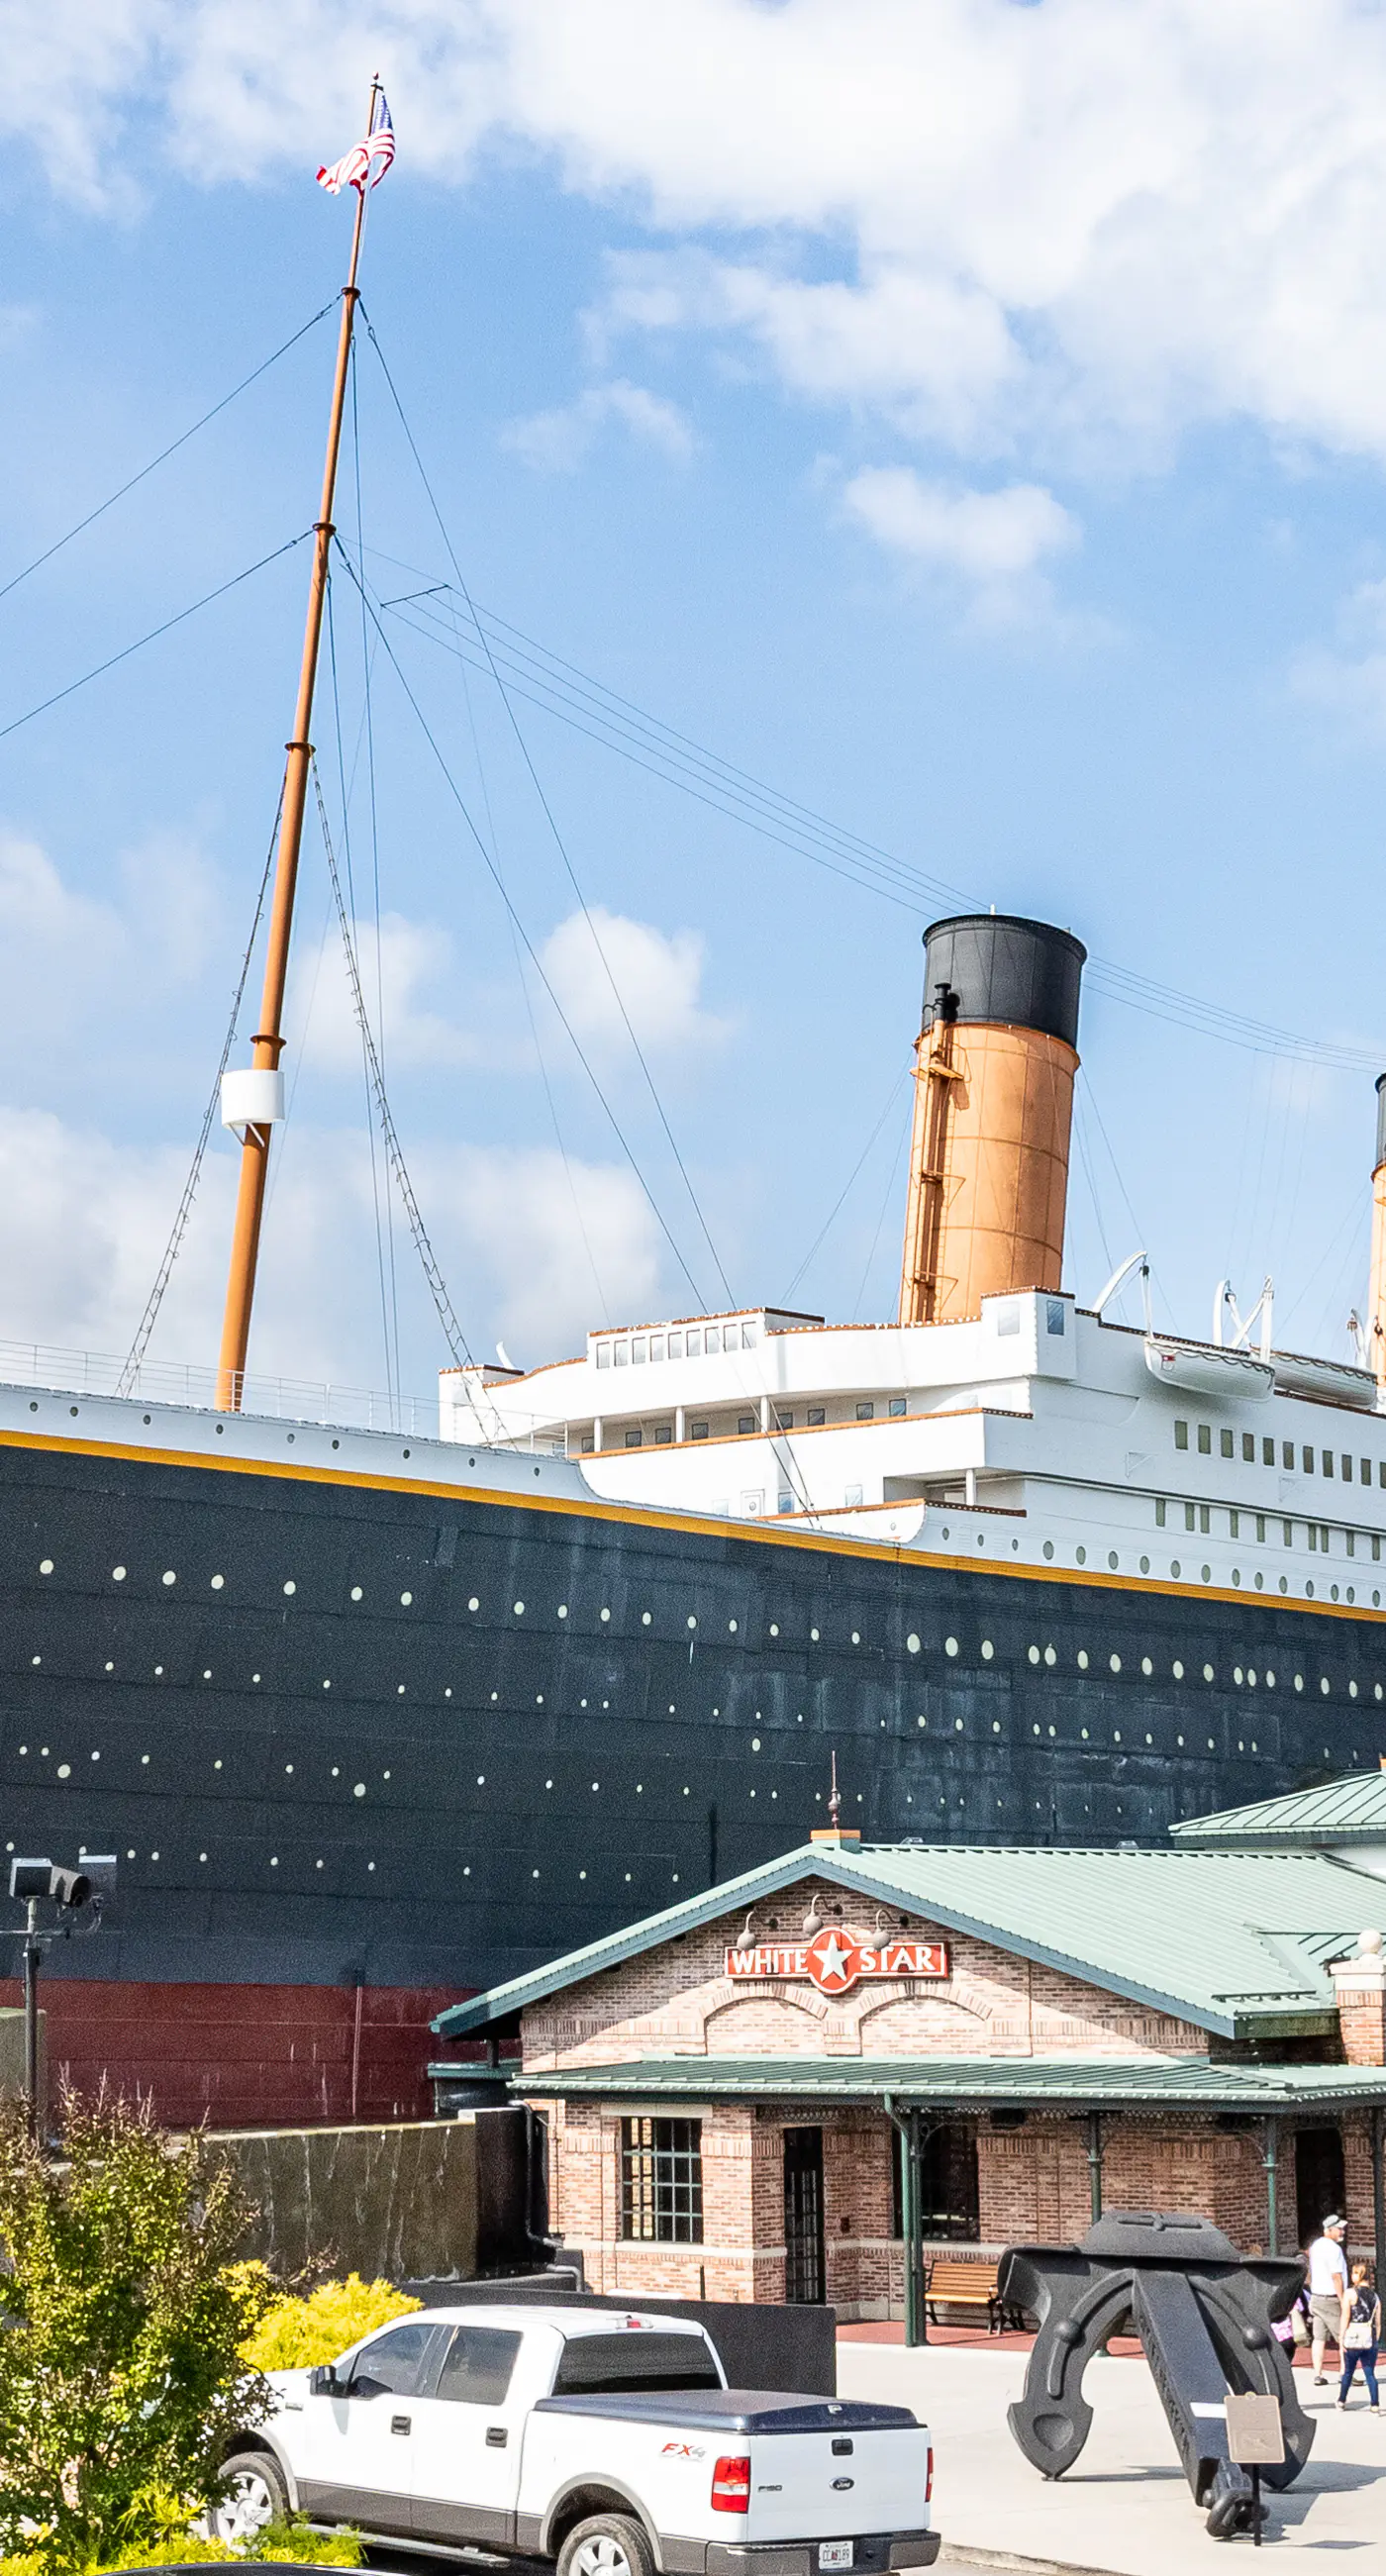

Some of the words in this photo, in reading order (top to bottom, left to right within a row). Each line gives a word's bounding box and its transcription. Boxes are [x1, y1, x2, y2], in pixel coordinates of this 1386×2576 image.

[732, 1948, 808, 1974] WHITE
[859, 1946, 936, 1971] STAR
[661, 2442, 707, 2457] FX4
